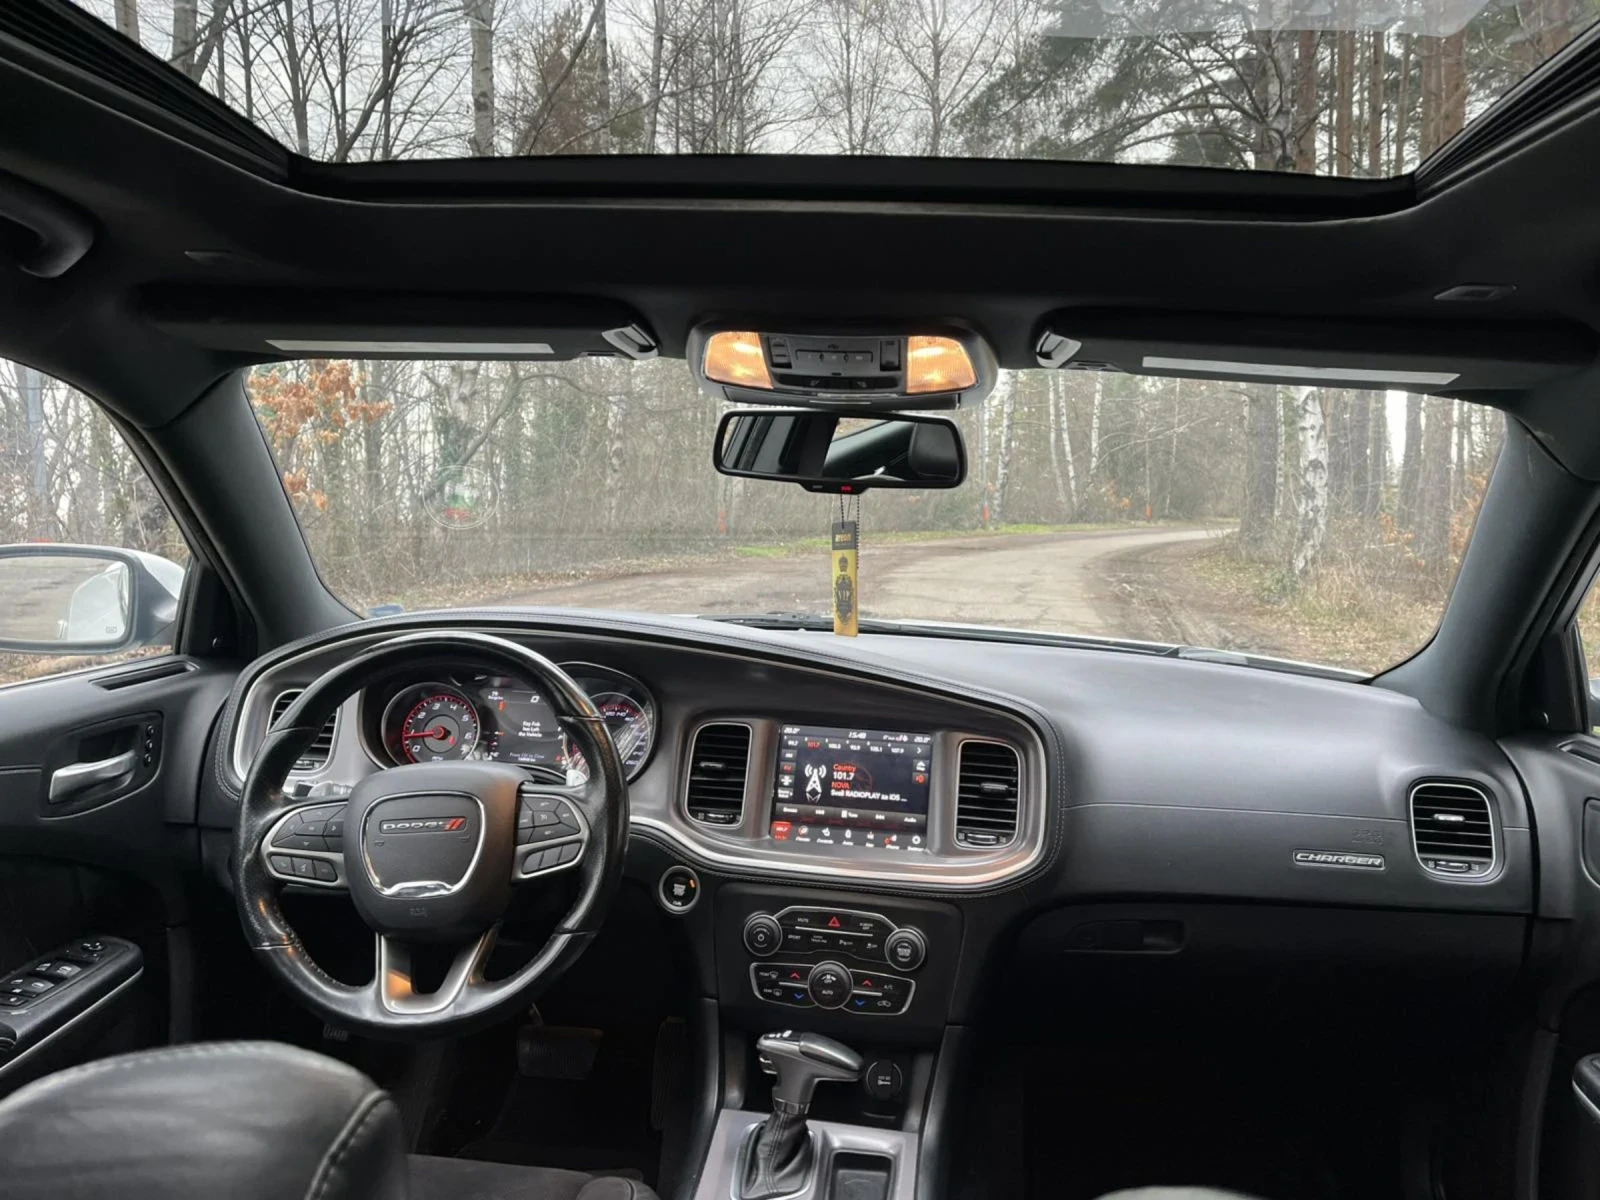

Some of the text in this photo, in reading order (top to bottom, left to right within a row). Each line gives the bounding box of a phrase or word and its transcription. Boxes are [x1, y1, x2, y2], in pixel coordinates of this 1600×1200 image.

[462, 714, 470, 722] 5
[464, 732, 473, 740] 6
[833, 764, 857, 772] Country
[833, 771, 855, 780] 101.7
[831, 781, 850, 789] NOVA
[845, 790, 880, 799] RADIOPLAY
[1296, 853, 1382, 865] CHARGER
